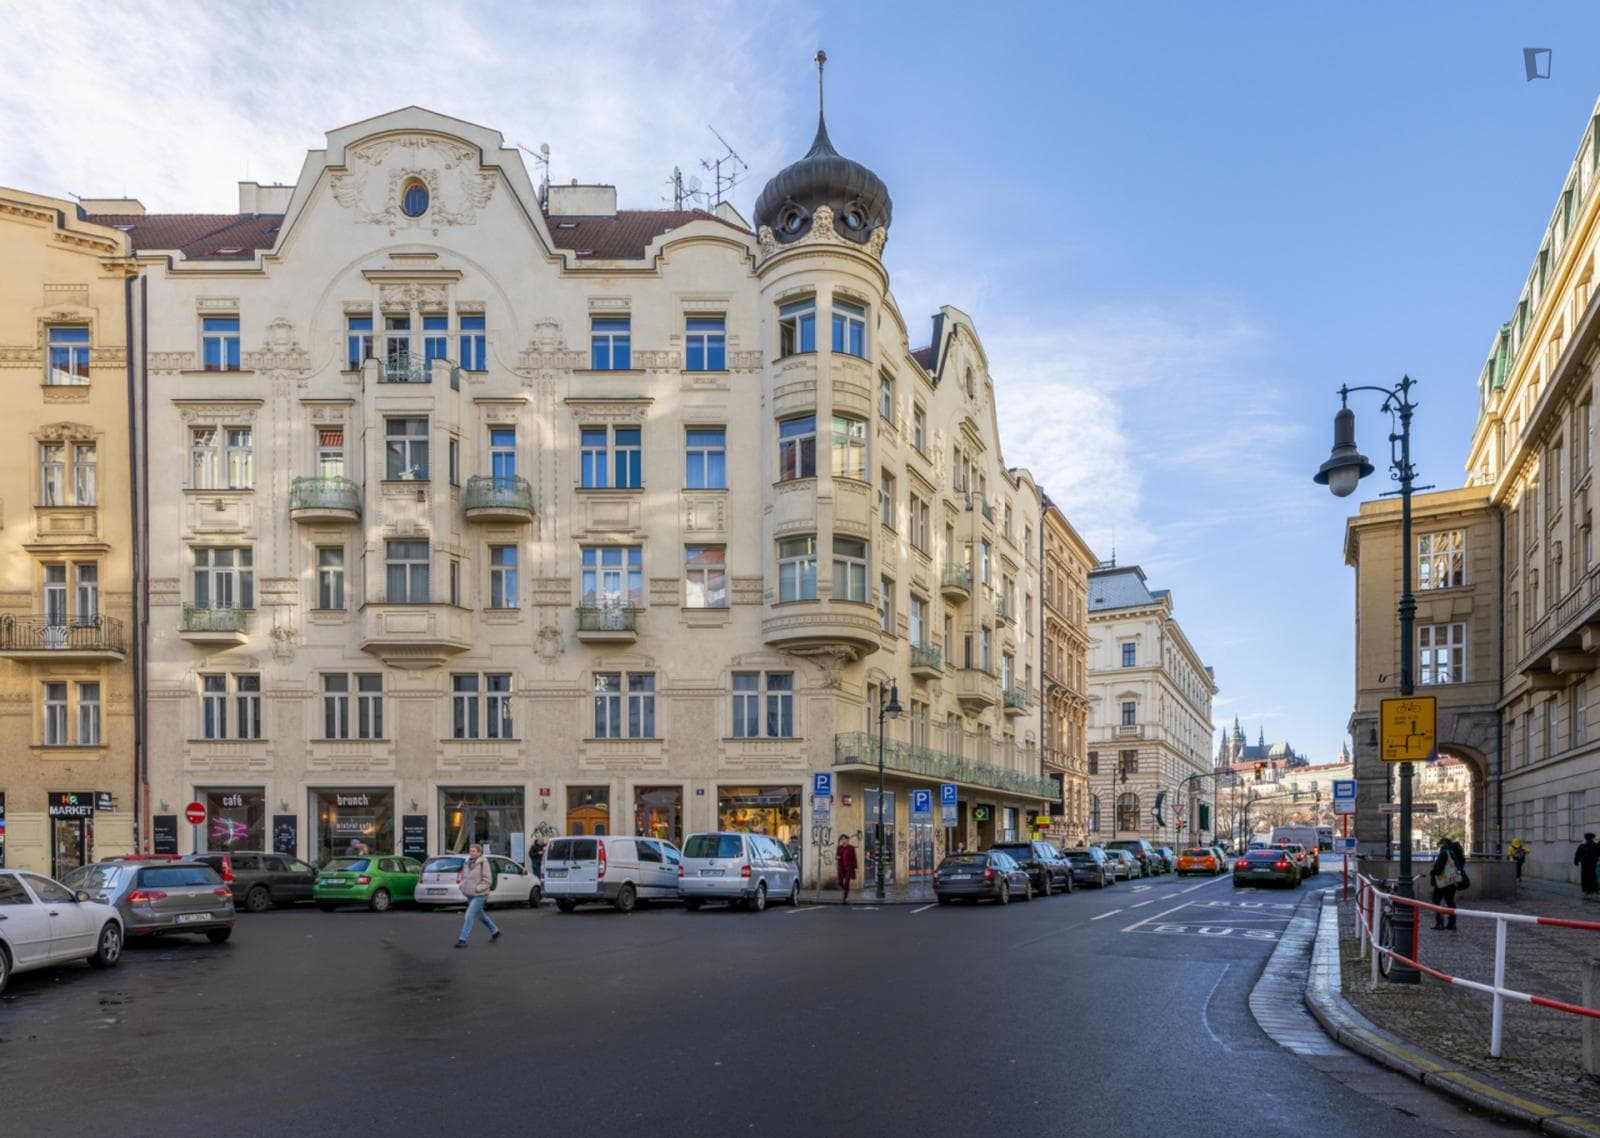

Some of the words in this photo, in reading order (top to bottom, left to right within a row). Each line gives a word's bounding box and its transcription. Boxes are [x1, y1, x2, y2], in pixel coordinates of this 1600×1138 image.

[817, 775, 828, 789] P
[222, 794, 243, 806] café
[337, 793, 368, 806] brunch
[916, 792, 927, 807] P
[944, 786, 953, 800] P
[49, 806, 92, 815] MARKET
[1152, 924, 1277, 939] BUS
